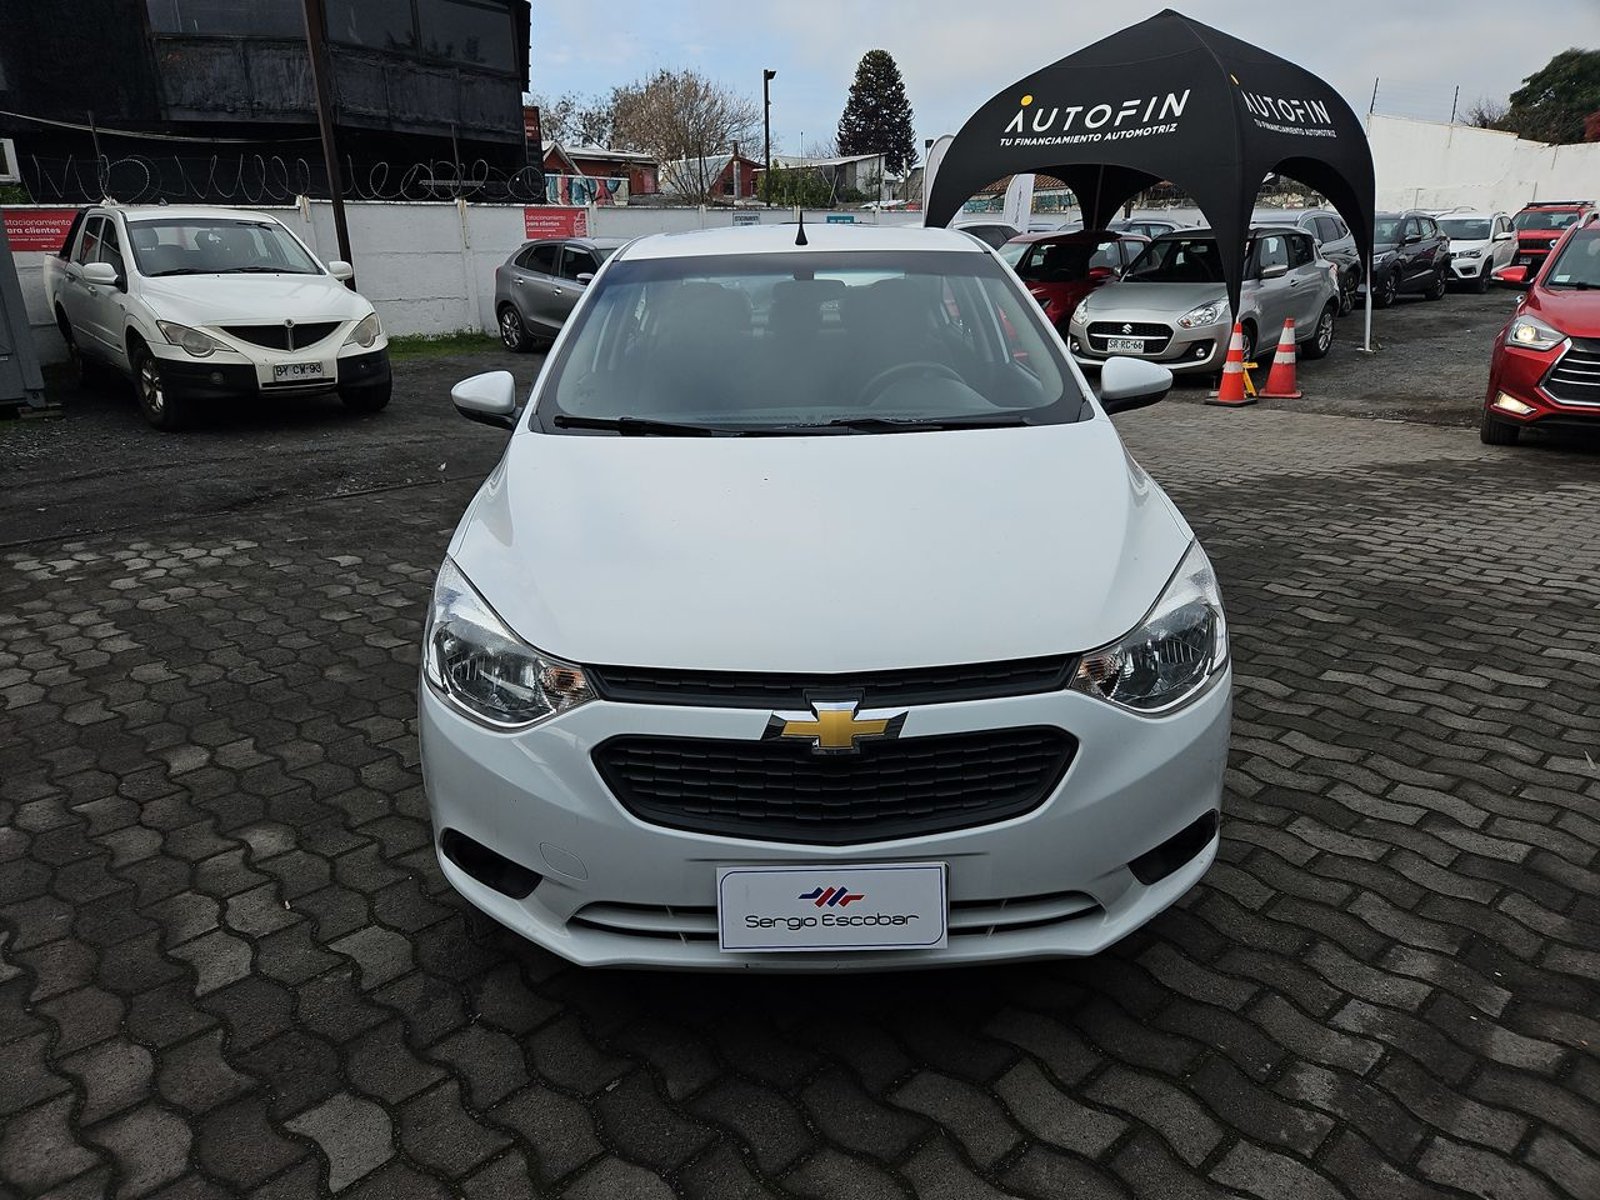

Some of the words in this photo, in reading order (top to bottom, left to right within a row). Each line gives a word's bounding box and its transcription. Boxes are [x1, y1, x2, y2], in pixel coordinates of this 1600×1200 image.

[1004, 89, 1191, 133] AUTOFIN
[1241, 89, 1332, 124] AUTOFIN
[1000, 137, 1013, 146] TU
[1014, 133, 1101, 146] FINANCIAMIENTO
[1104, 123, 1178, 141] AUTOMOTRIZ
[25, 226, 61, 234] clientes
[744, 914, 818, 931] Sergio
[821, 912, 920, 928] Escobar
